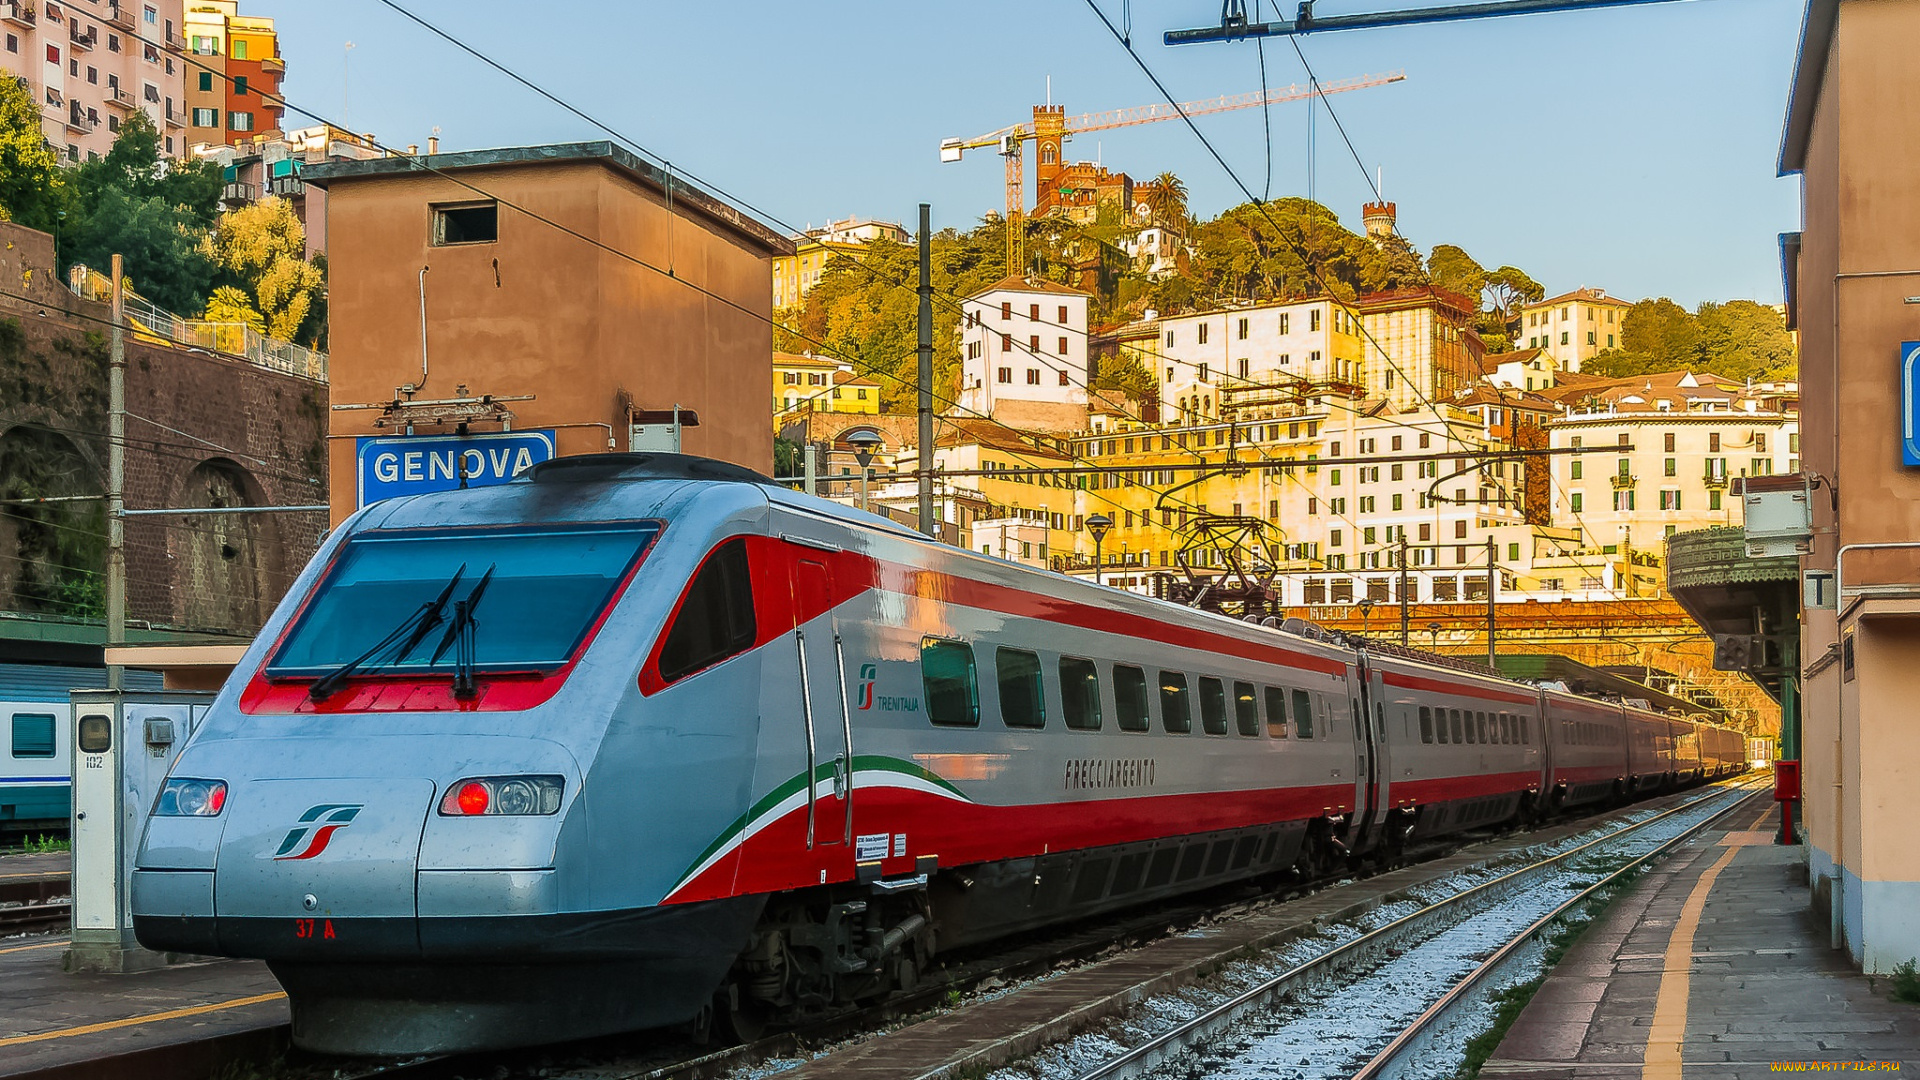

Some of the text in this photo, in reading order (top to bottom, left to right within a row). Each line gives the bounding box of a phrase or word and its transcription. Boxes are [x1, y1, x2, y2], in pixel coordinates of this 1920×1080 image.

[374, 447, 534, 482] GENOVA
[1806, 573, 1833, 605] T
[877, 696, 919, 711] TRENITALIA
[86, 756, 103, 769] 102
[1065, 758, 1155, 789] FRECCIARGENTO
[296, 918, 336, 939] 37 A
